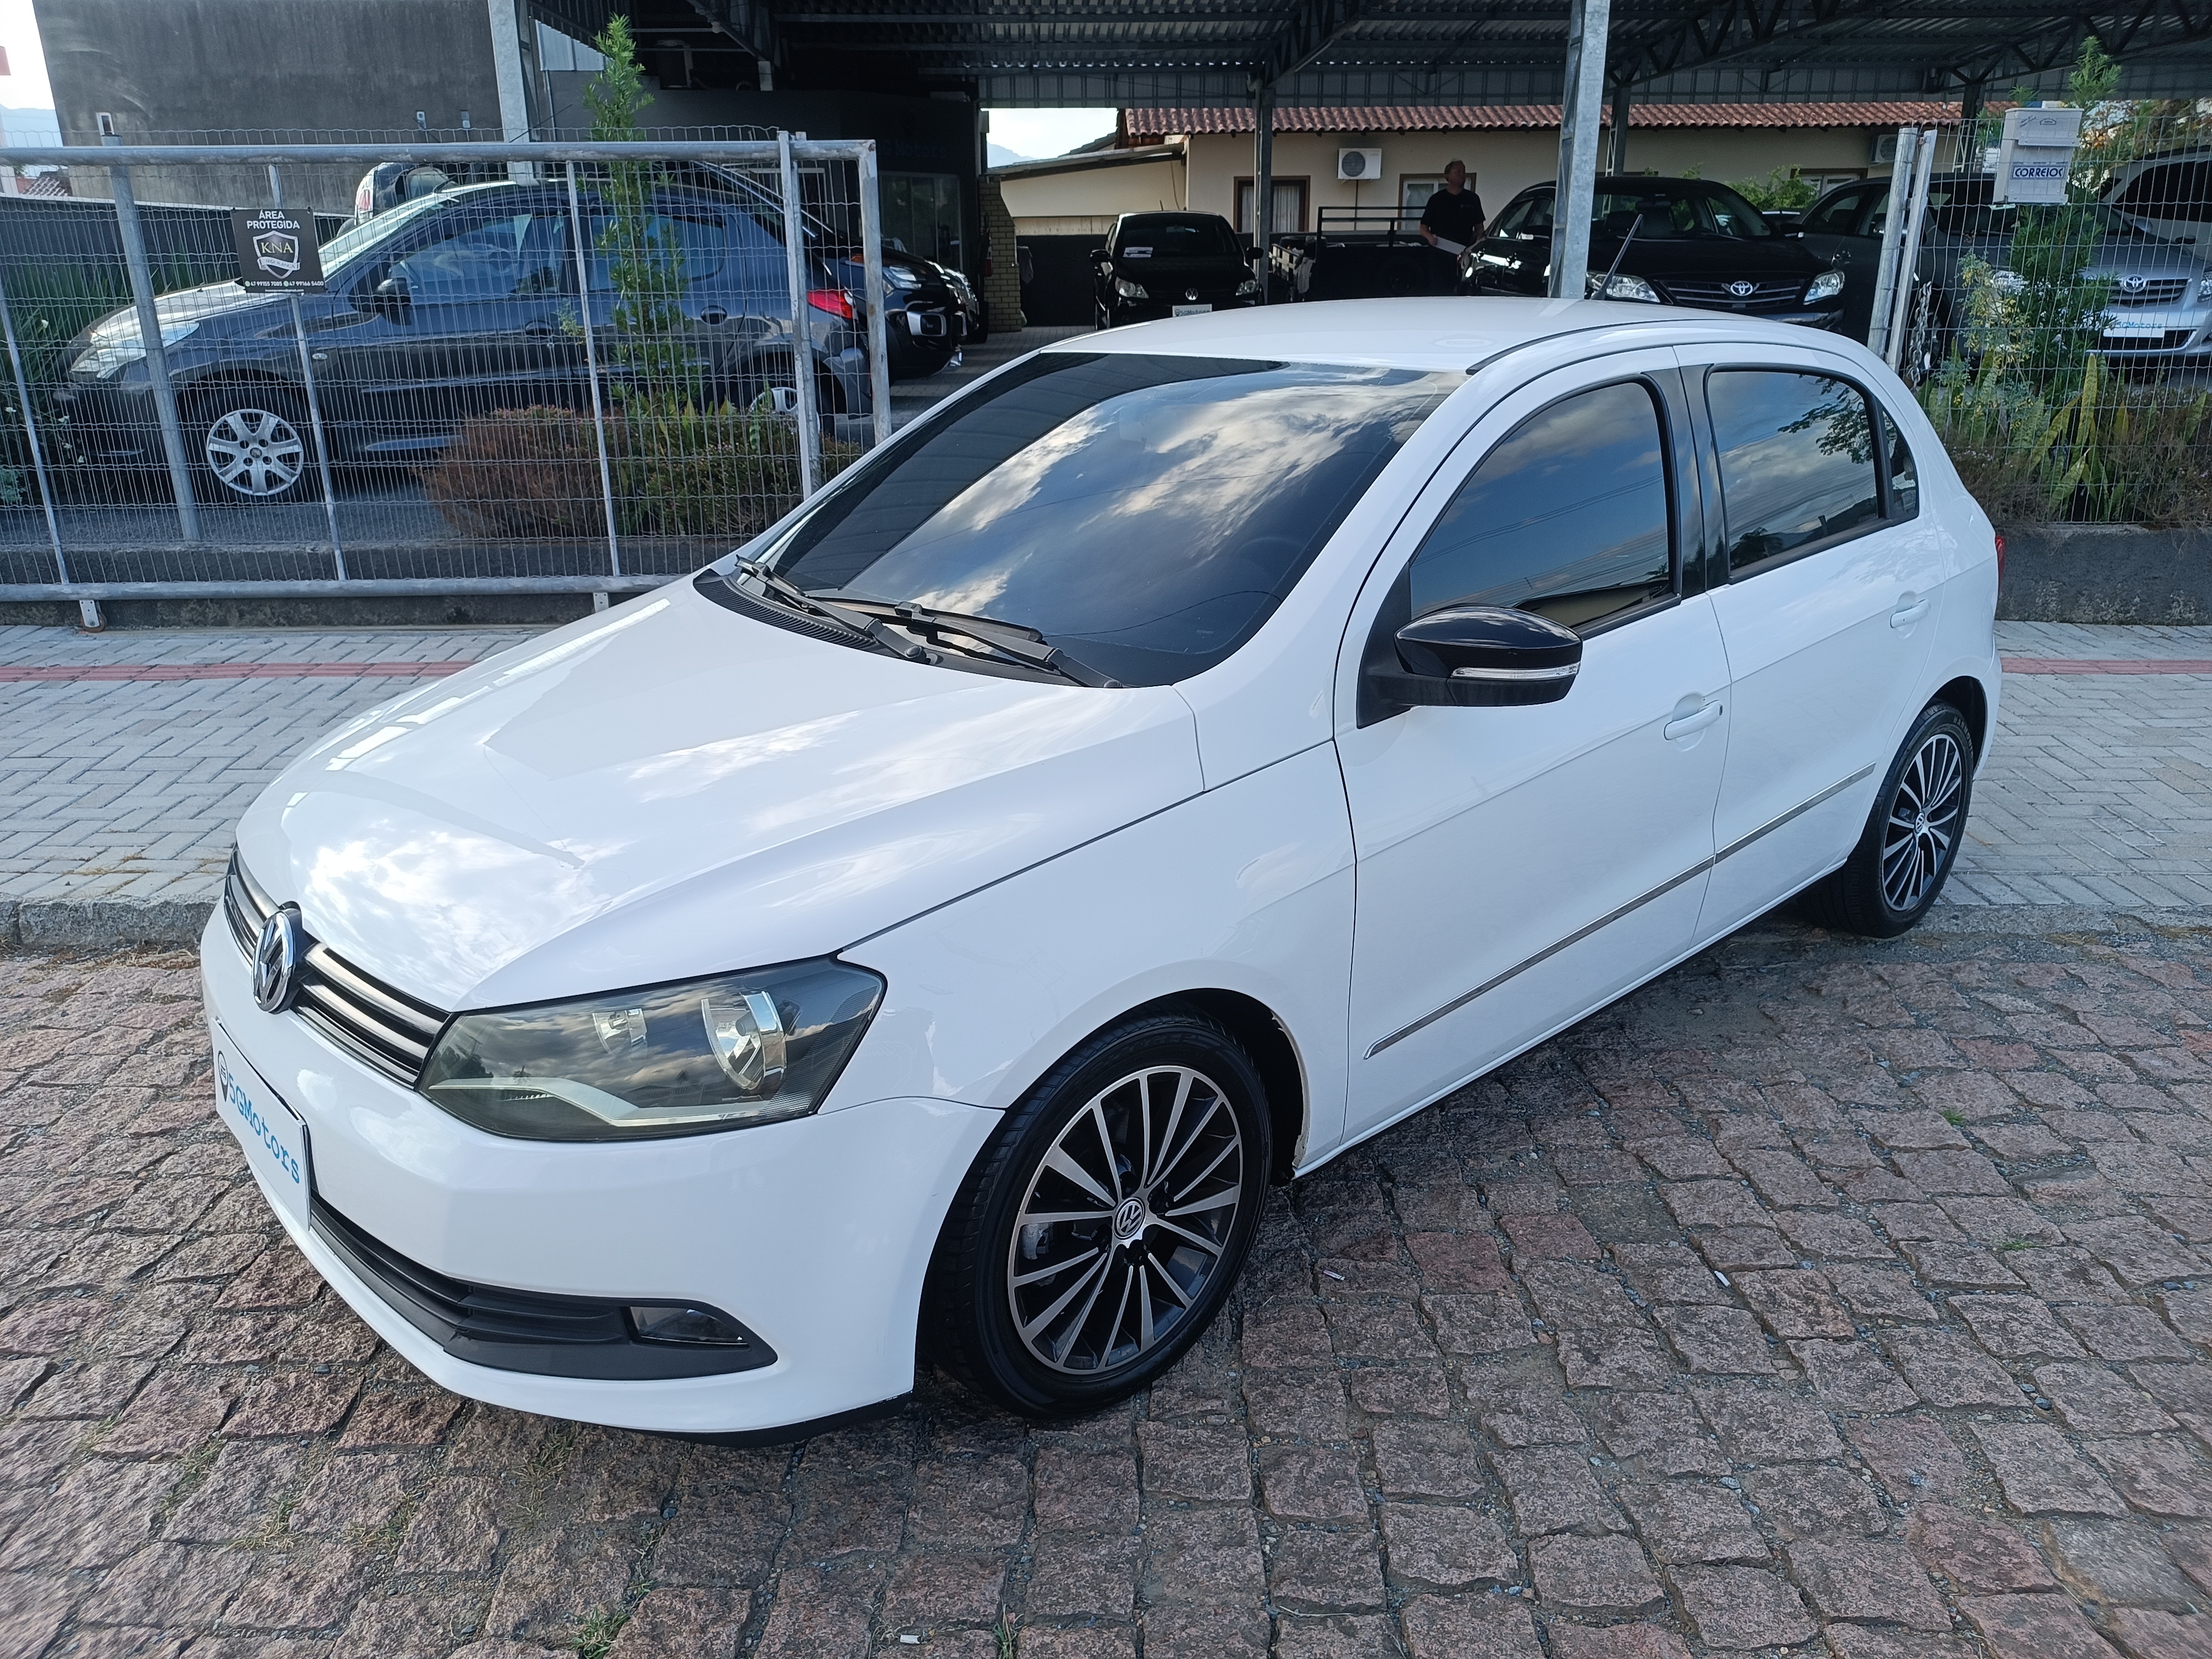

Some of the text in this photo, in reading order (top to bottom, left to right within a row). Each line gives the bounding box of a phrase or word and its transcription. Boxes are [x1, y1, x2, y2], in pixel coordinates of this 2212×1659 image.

[259, 210, 285, 220] ÁREA
[247, 221, 300, 229] PROTEGIDA
[260, 242, 294, 253] KNA
[228, 1072, 300, 1184] 5GMotors
